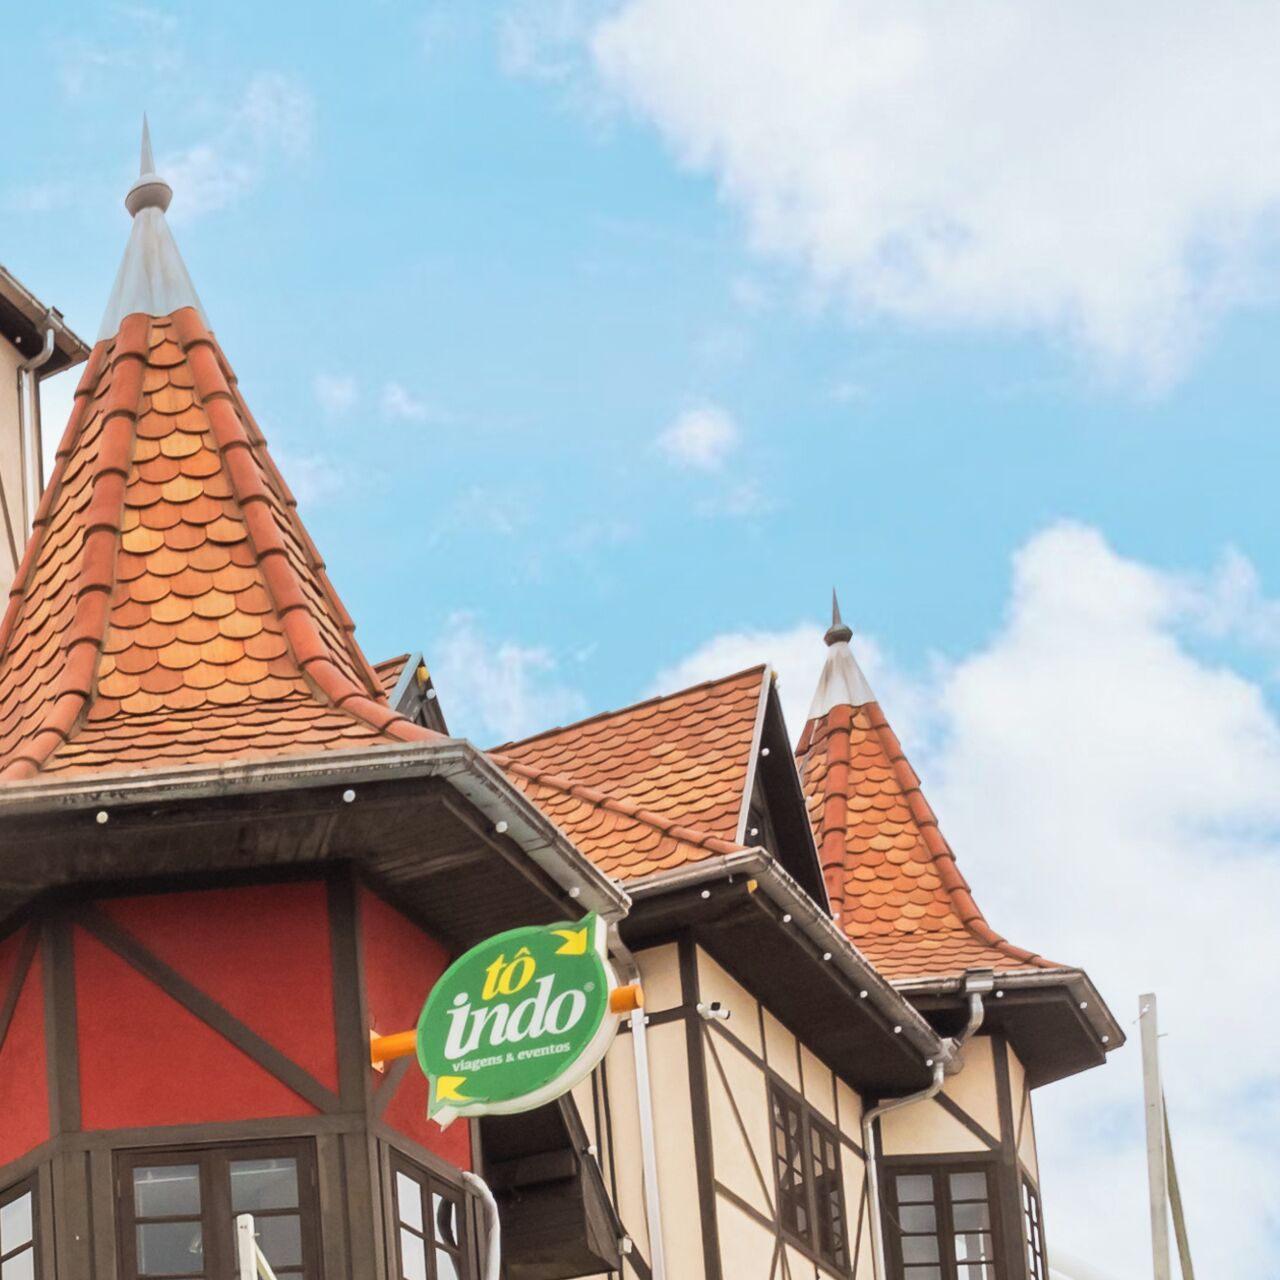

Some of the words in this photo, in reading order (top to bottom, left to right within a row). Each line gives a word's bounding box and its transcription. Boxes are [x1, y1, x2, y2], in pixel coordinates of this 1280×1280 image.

[481, 946, 536, 1001] tô
[444, 973, 587, 1060] indo
[452, 1054, 503, 1073] viagens
[506, 1053, 514, 1062] &
[517, 1042, 571, 1060] eventos
